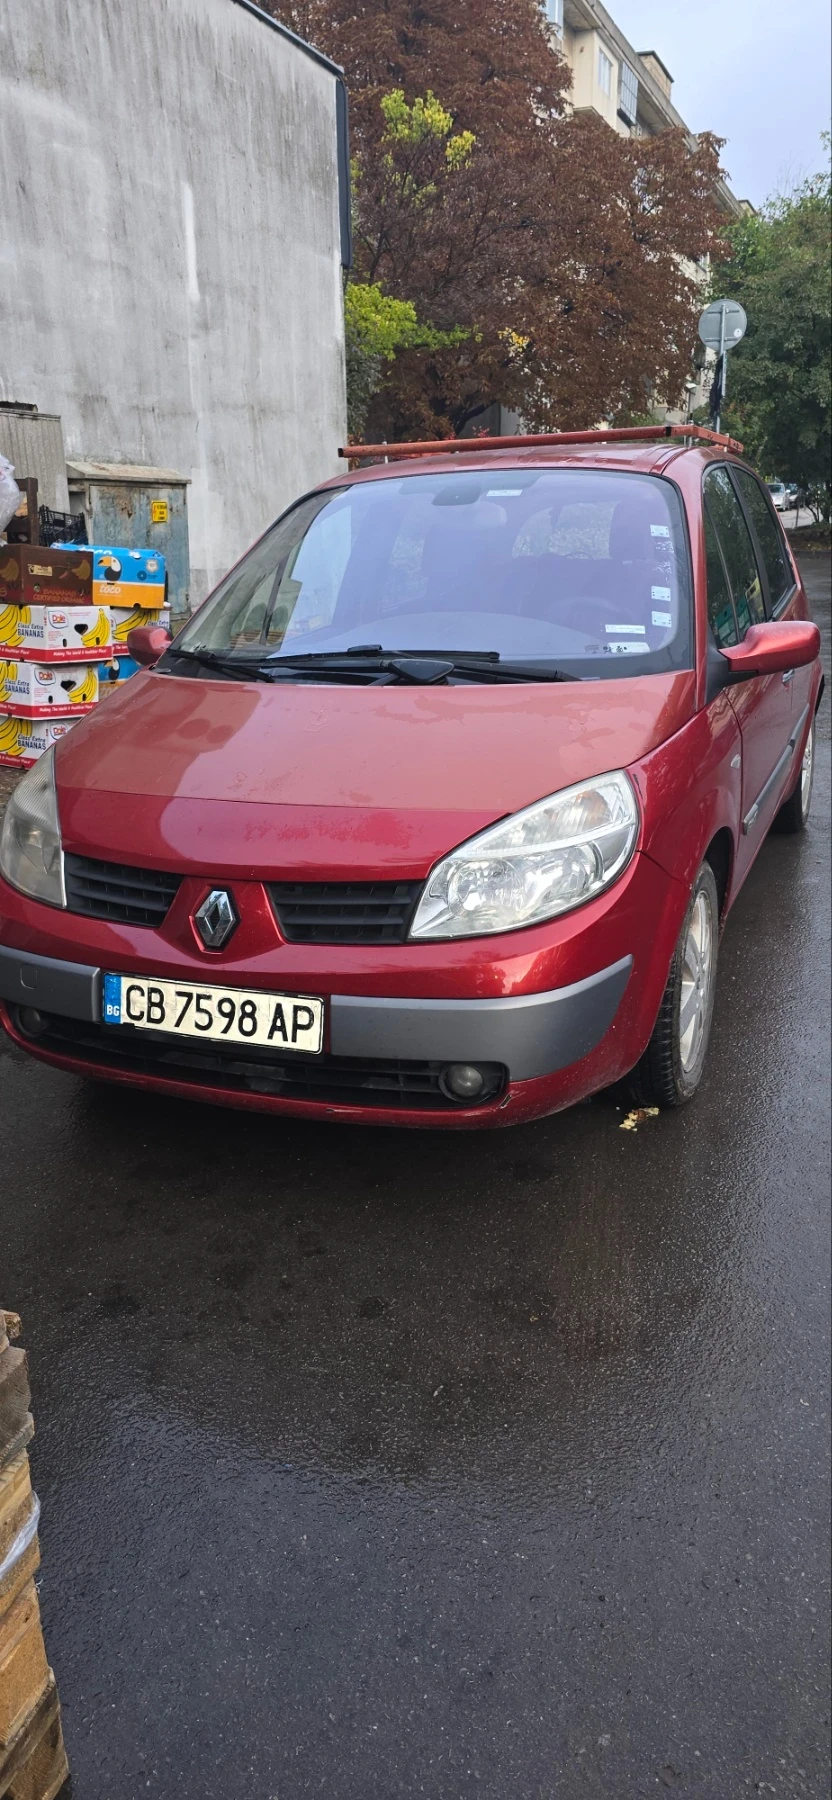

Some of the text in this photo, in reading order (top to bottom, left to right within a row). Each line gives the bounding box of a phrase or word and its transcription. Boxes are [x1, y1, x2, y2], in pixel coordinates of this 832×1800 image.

[52, 614, 66, 623] Dole
[17, 628, 44, 638] BANANAS
[39, 671, 53, 680] Dole
[4, 684, 30, 694] BANANAS
[53, 725, 67, 736] Dole
[17, 740, 46, 750] BANANAS
[106, 1004, 120, 1016] BG
[126, 984, 315, 1043] CB 7598 AP
